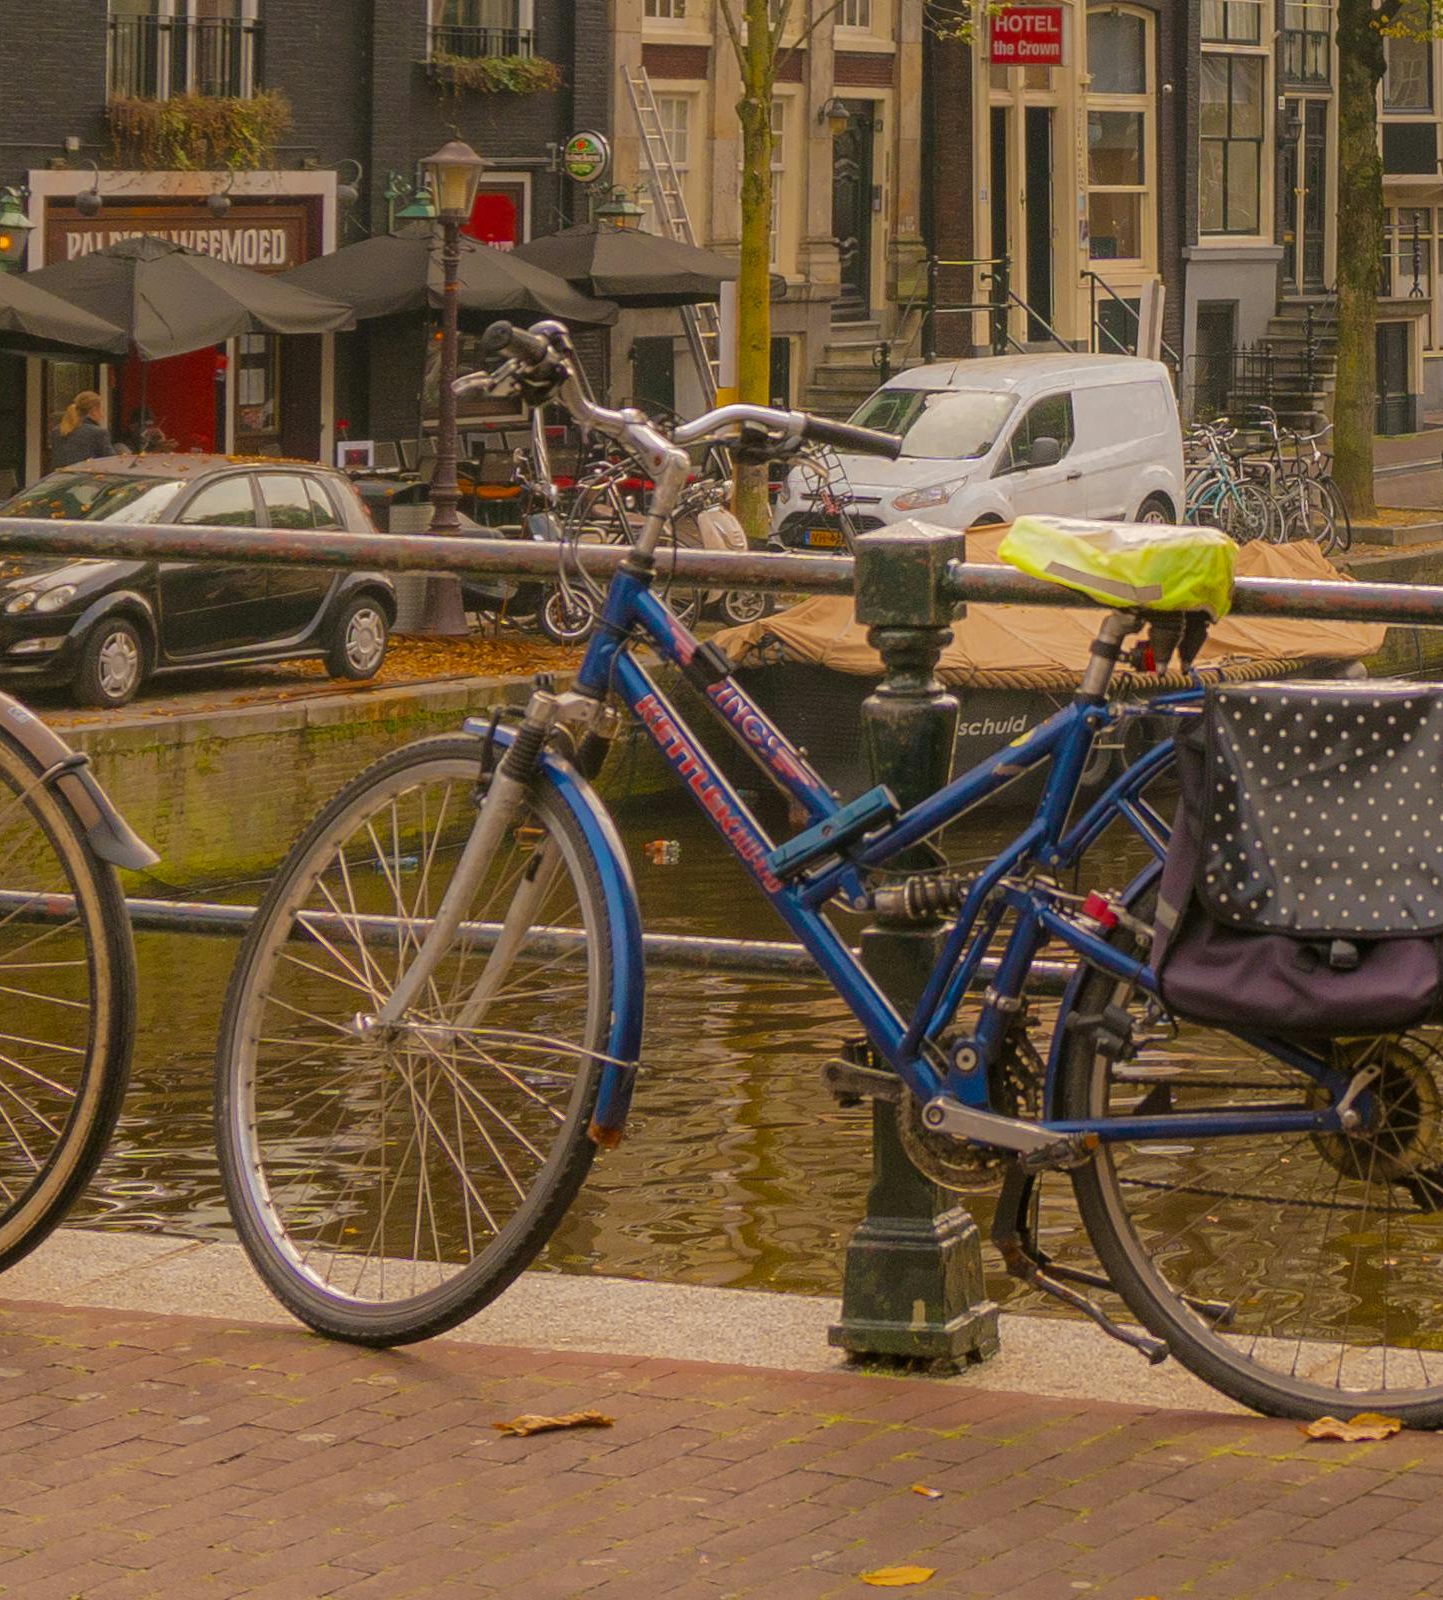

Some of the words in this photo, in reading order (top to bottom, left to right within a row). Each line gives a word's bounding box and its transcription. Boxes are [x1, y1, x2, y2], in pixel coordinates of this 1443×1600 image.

[995, 15, 1058, 33] HOTEL
[993, 40, 1015, 56] the
[1018, 40, 1060, 56] Crown
[958, 714, 1027, 736] schuld
